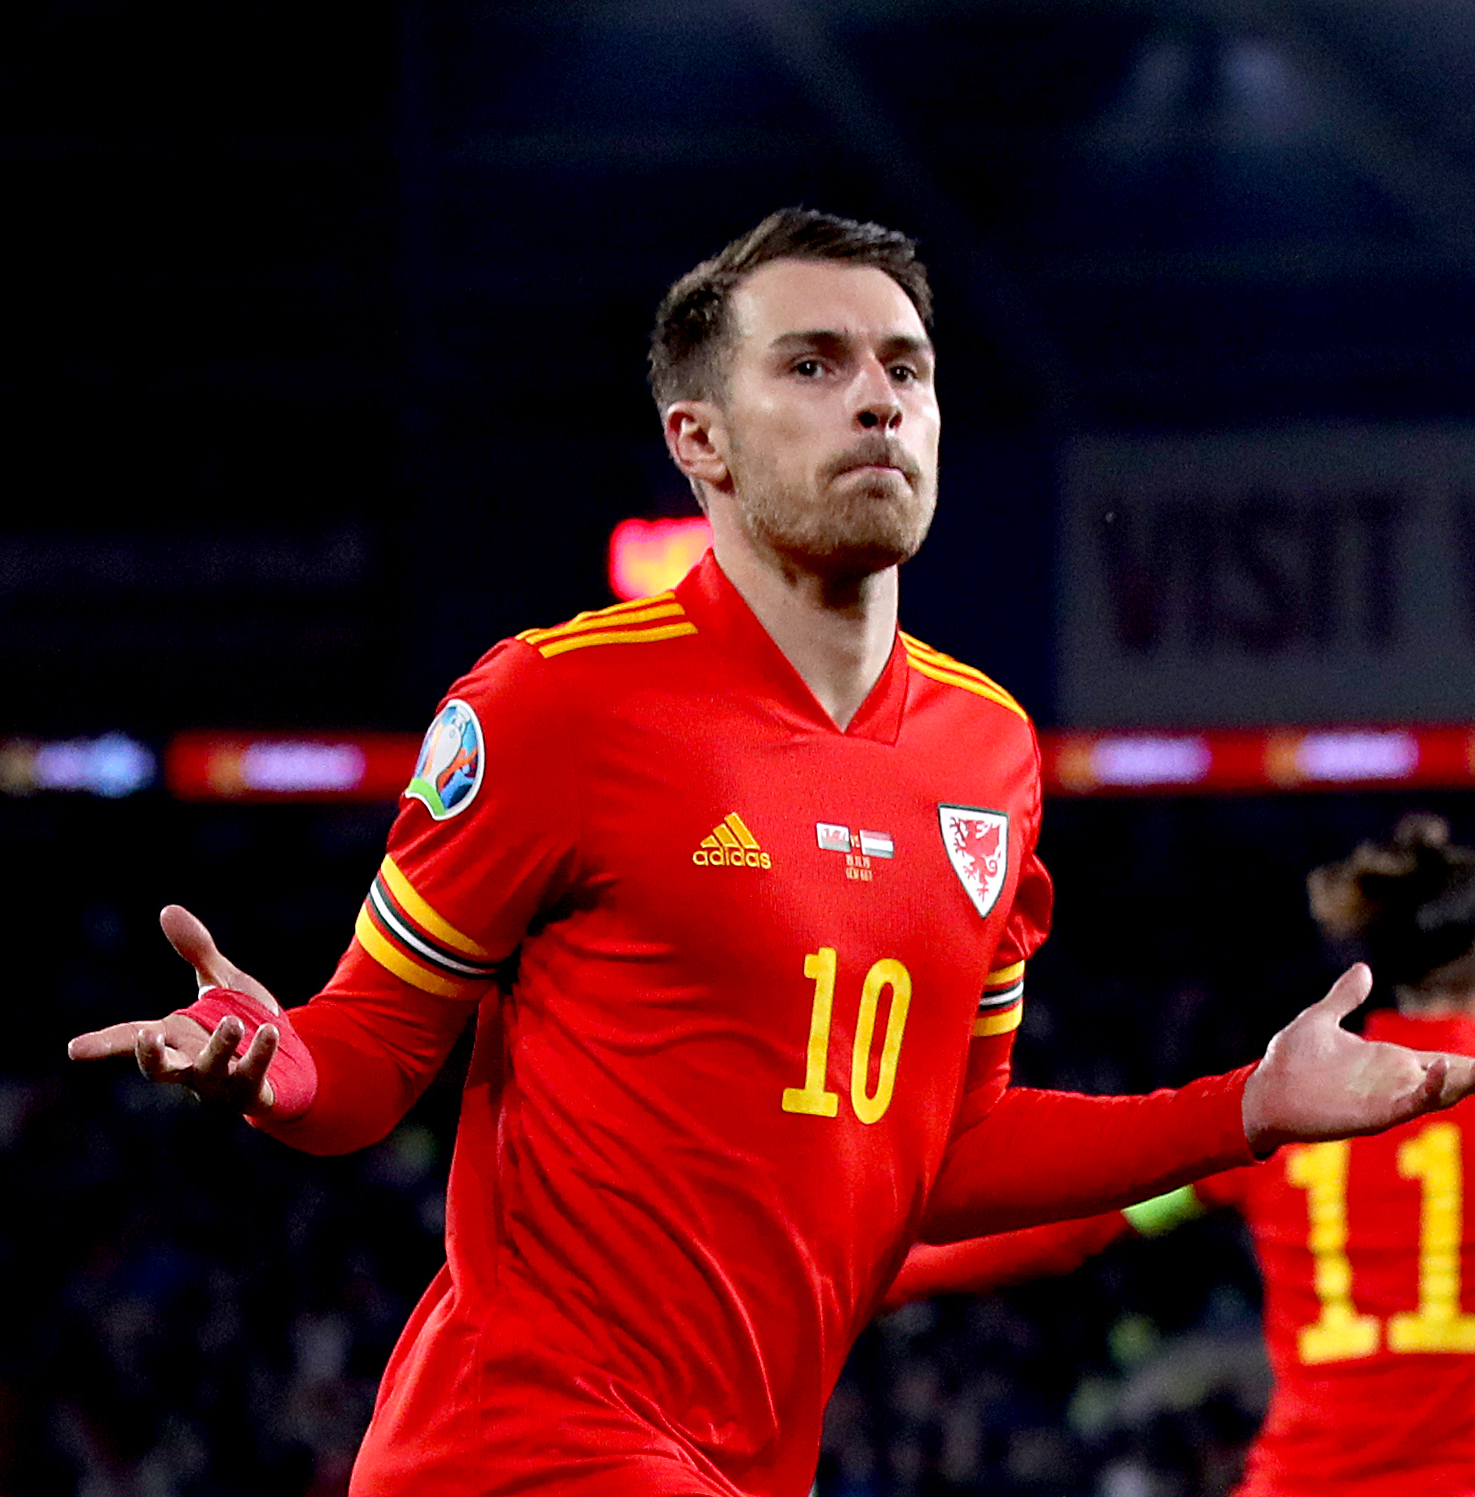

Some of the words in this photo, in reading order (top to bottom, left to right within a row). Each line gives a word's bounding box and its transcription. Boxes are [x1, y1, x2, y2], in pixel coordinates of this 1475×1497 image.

[1099, 484, 1405, 654] VISIT
[692, 847, 772, 870] adidas
[782, 946, 913, 1125] 10
